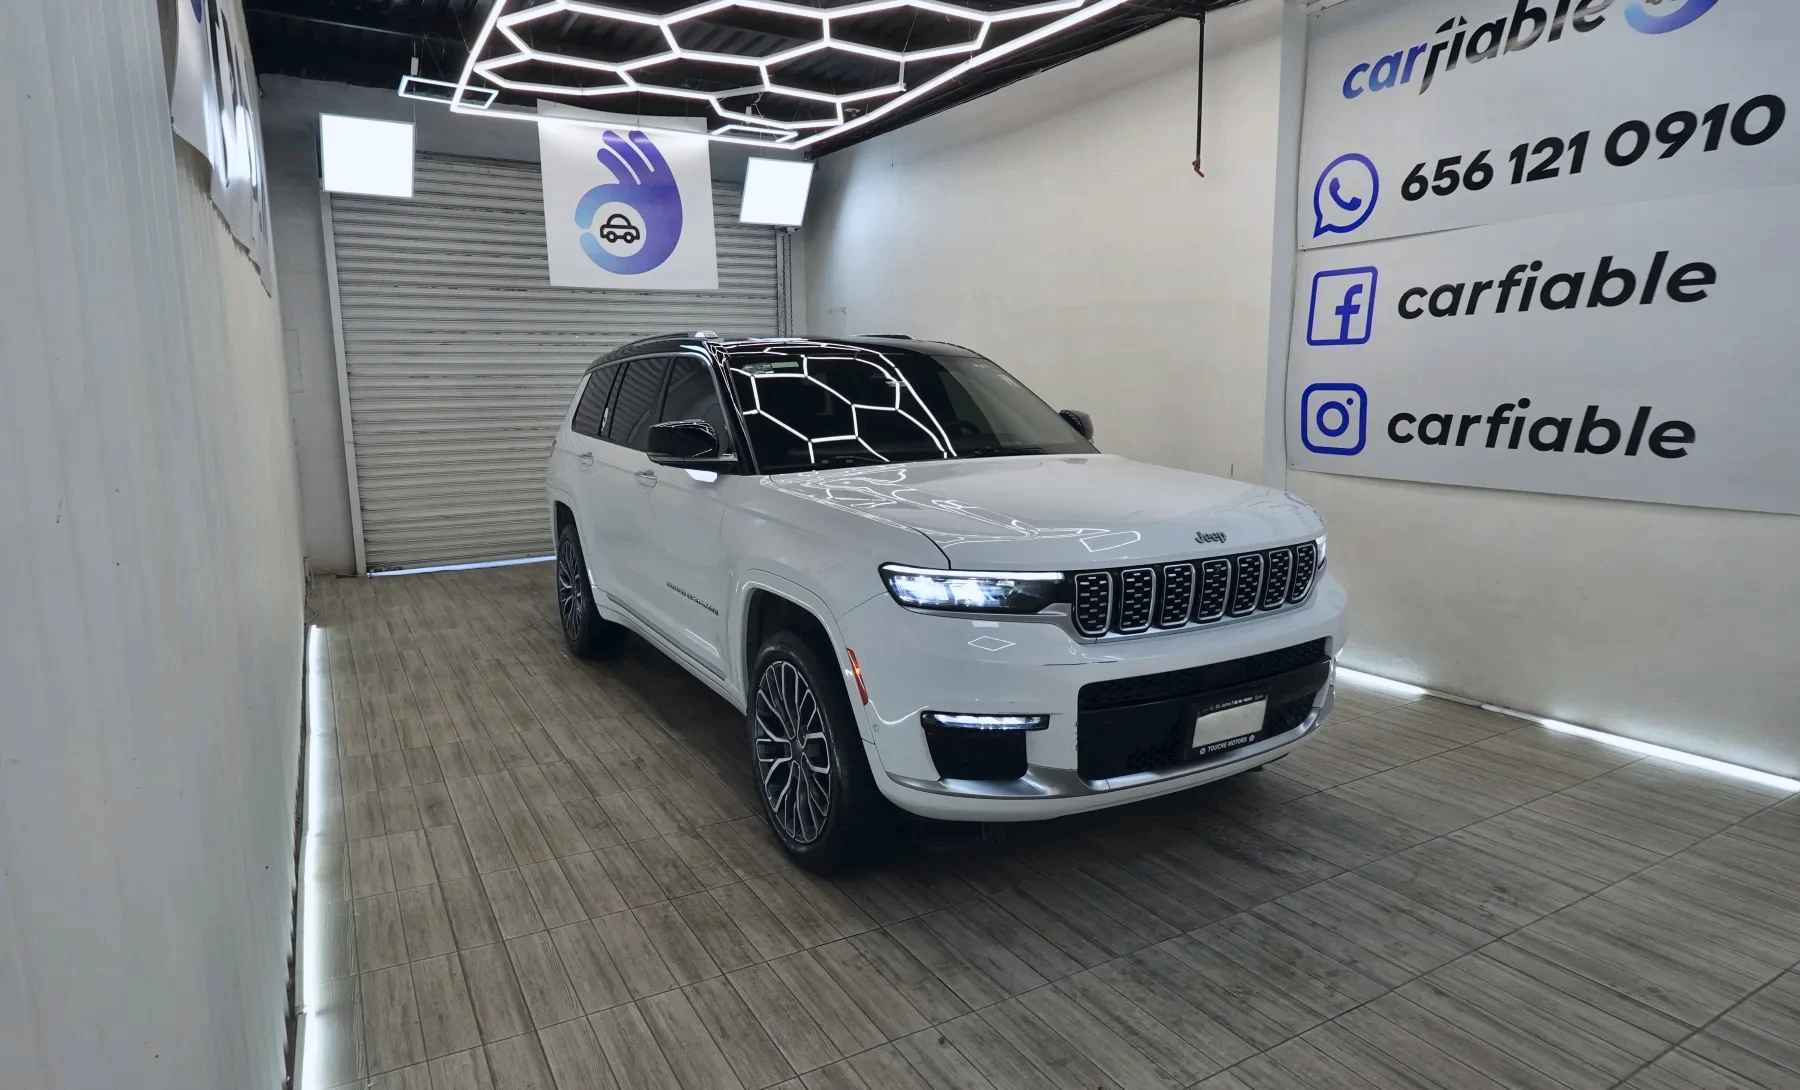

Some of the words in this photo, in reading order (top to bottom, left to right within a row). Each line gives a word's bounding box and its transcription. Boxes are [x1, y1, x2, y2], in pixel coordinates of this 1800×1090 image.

[1342, 0, 1613, 99] carfiable
[1400, 149, 1494, 202] 656
[1508, 130, 1591, 185] 121
[1604, 94, 1786, 167] 0910
[1397, 250, 1717, 320] carfiable
[1387, 397, 1696, 459] carfiable
[1194, 531, 1227, 543] Jeep
